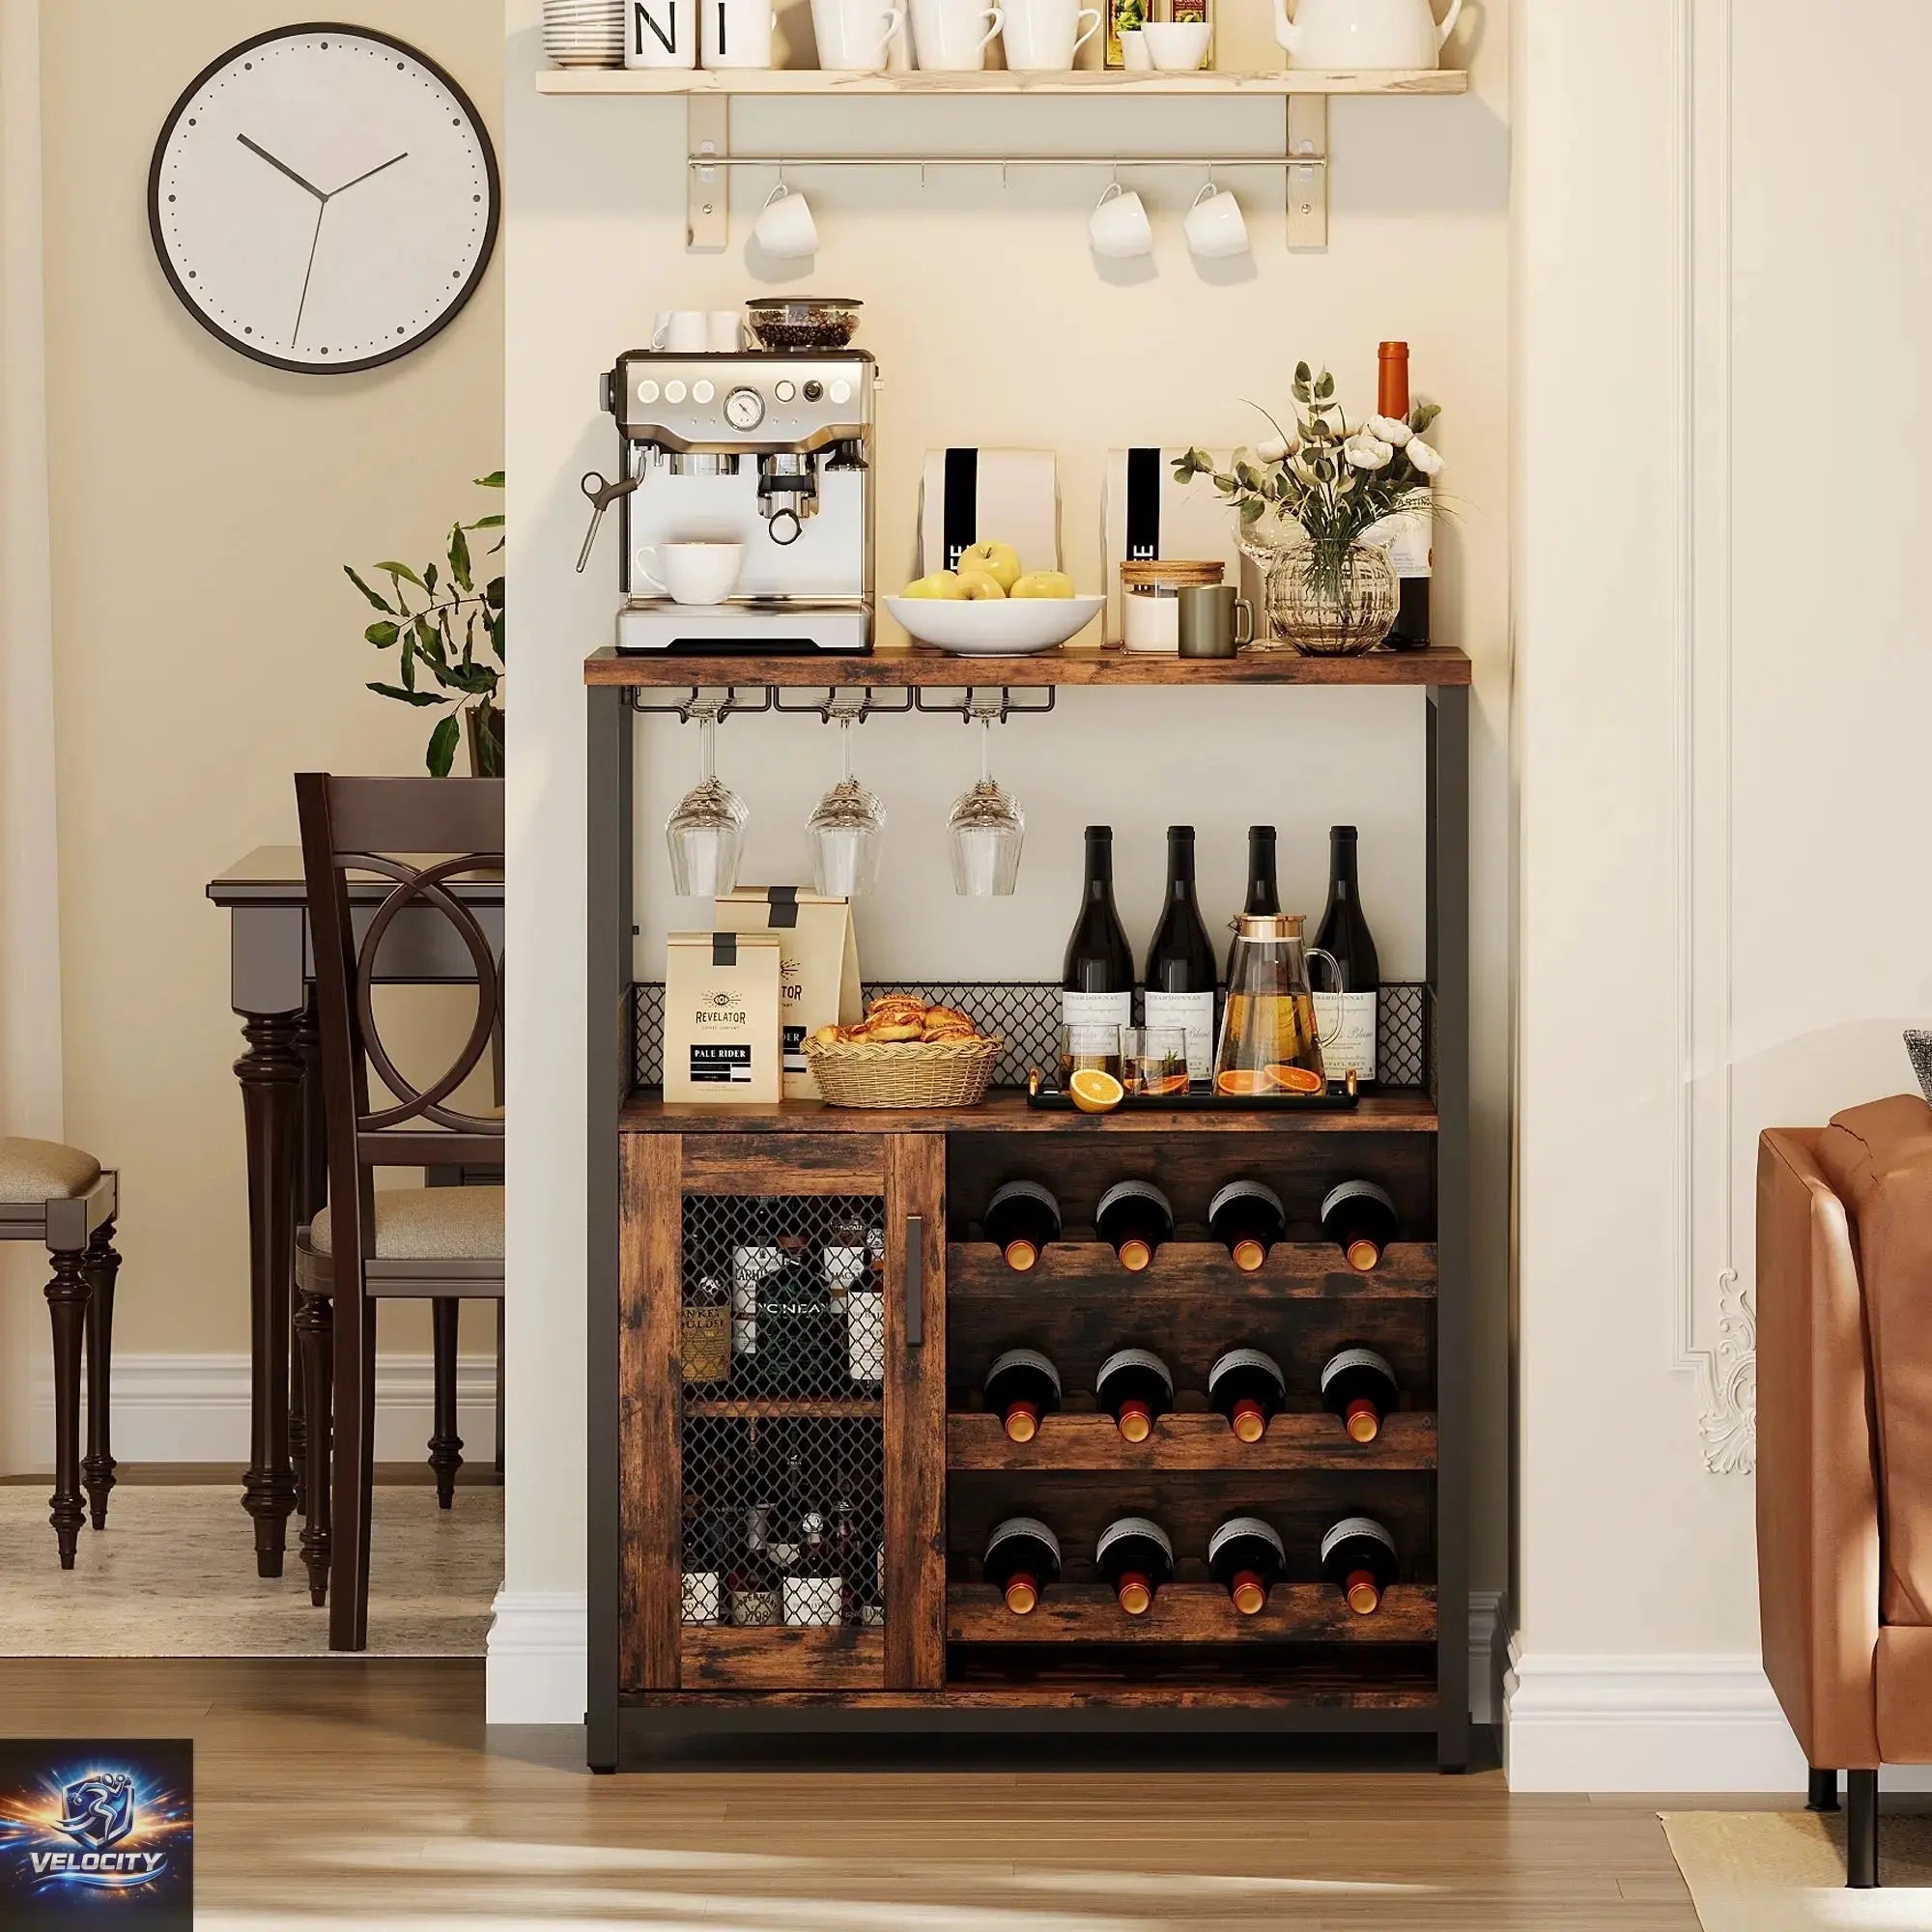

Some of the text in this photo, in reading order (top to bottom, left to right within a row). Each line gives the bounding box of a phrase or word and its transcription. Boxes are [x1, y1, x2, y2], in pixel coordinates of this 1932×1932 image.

[634, 2, 676, 54] N
[718, 2, 726, 55] I
[696, 1010, 746, 1024] REVELATOR
[695, 1049, 746, 1058] PALE RIDER
